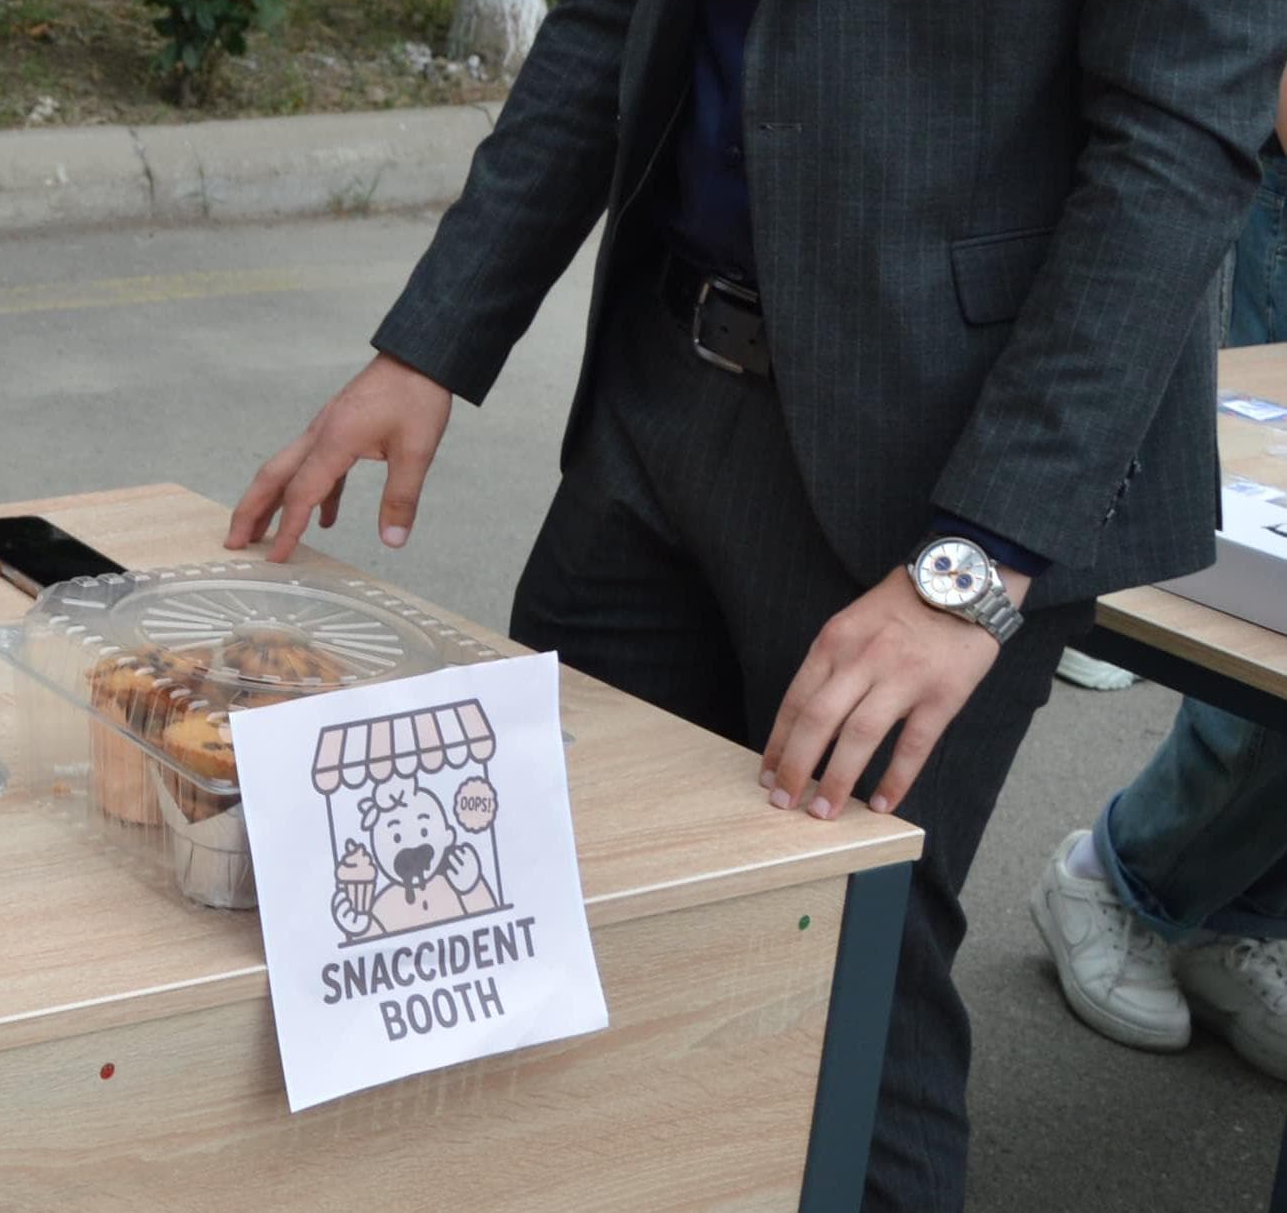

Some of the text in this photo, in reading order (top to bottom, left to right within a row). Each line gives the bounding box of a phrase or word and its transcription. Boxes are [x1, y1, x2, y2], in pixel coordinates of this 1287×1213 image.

[459, 795, 493, 814] OOPS!
[321, 916, 538, 1004] SNACCIDENT
[379, 977, 505, 1041] BOOTH
